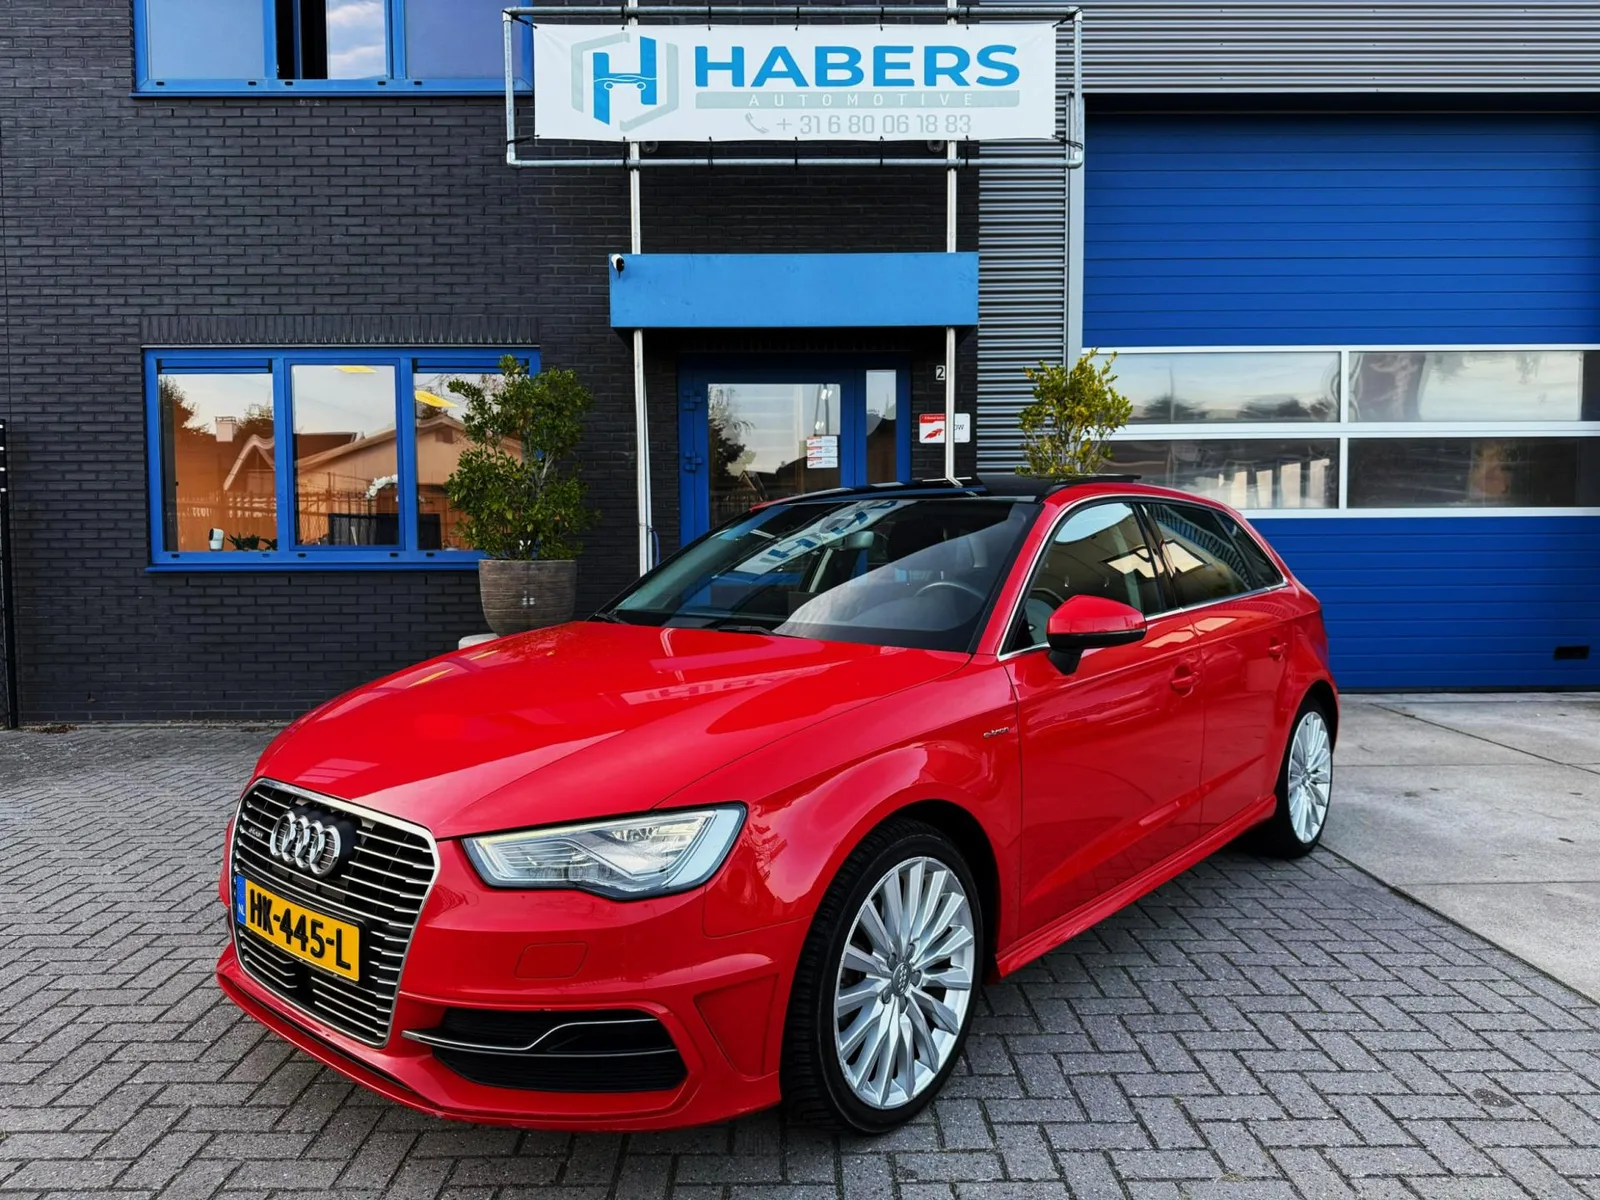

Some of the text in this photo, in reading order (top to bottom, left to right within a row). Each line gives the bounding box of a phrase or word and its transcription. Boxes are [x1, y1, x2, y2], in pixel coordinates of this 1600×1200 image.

[695, 44, 1020, 87] HABERS
[748, 93, 973, 107] AUTOMOTIVE
[800, 115, 820, 134] 31
[827, 115, 841, 134] 6
[848, 115, 875, 134] 80
[882, 115, 909, 134] 06
[916, 114, 937, 133] 18
[944, 114, 971, 133] 83
[249, 888, 351, 971] HK-445-L
